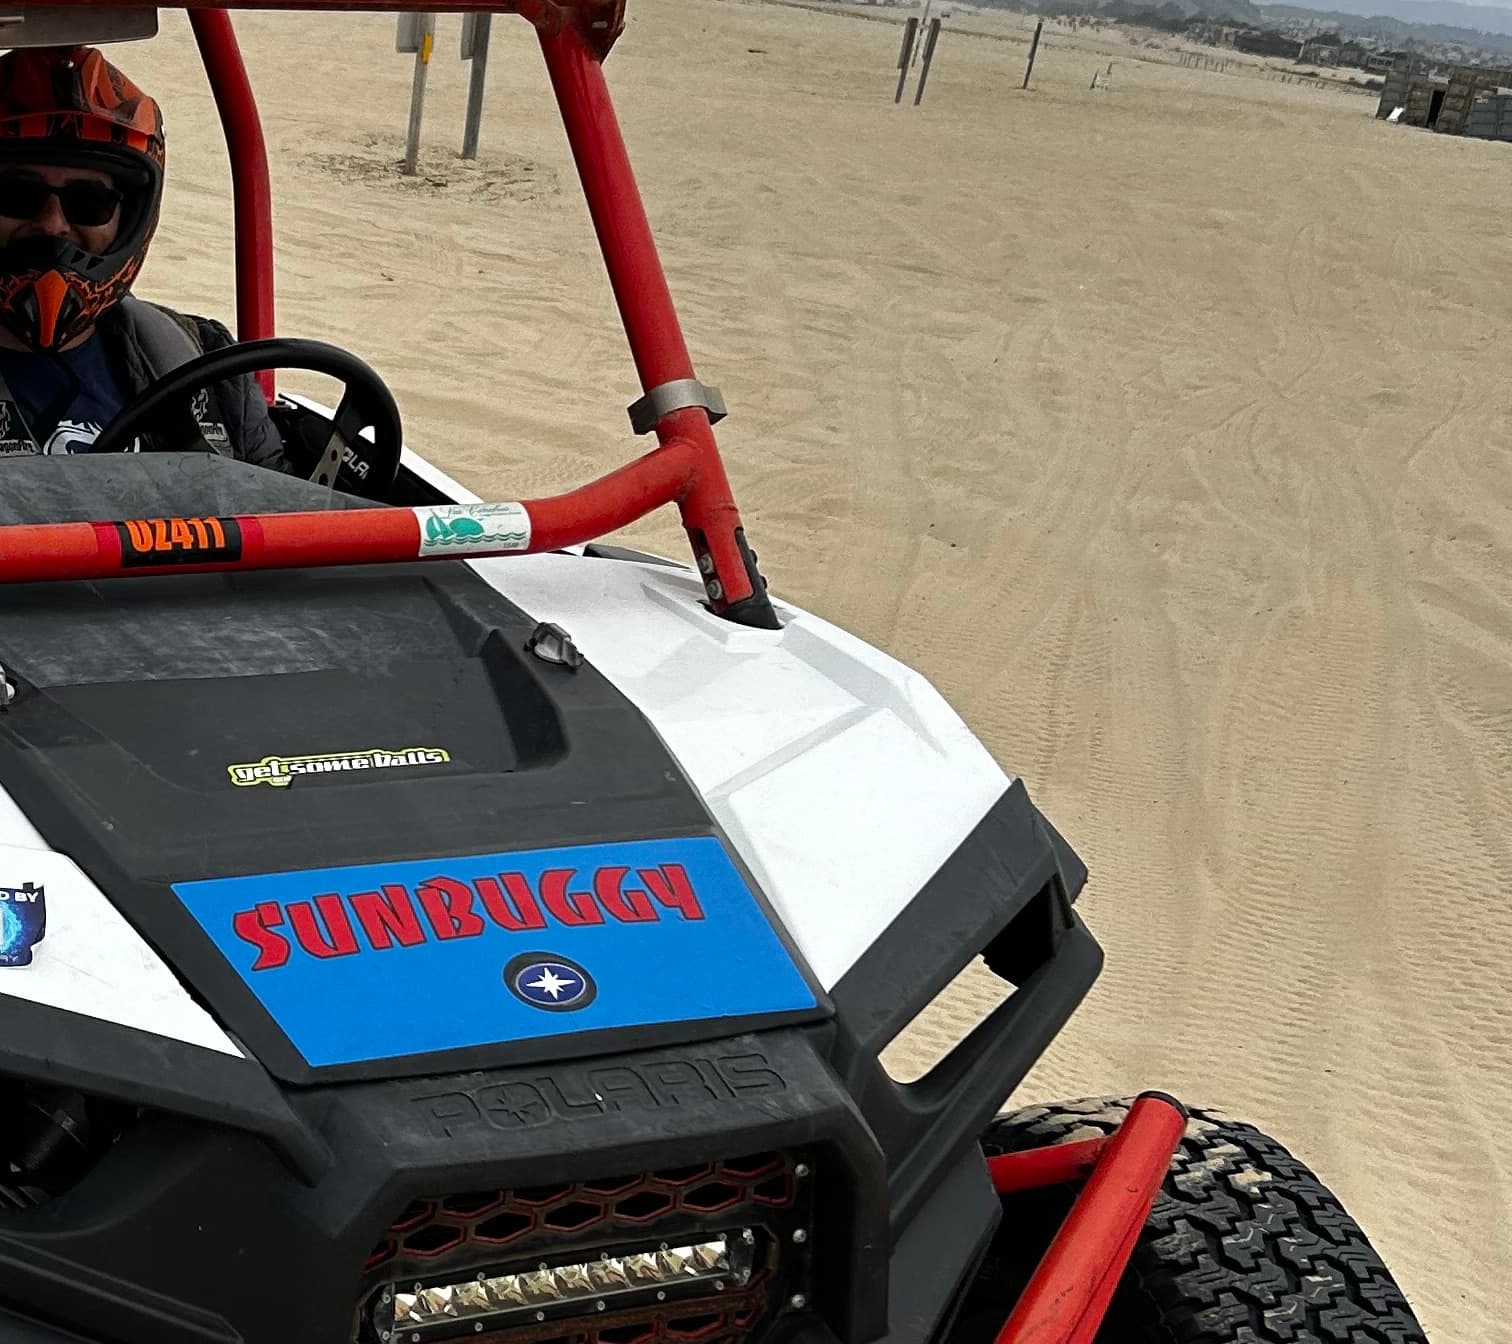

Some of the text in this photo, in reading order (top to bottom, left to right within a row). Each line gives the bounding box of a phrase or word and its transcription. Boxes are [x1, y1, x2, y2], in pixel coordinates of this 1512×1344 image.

[236, 761, 286, 782] get
[289, 757, 370, 775] some
[373, 751, 443, 768] balls
[14, 891, 39, 903] BY
[232, 863, 707, 972] SUNBUGGY
[409, 1052, 788, 1139] POLARIS
